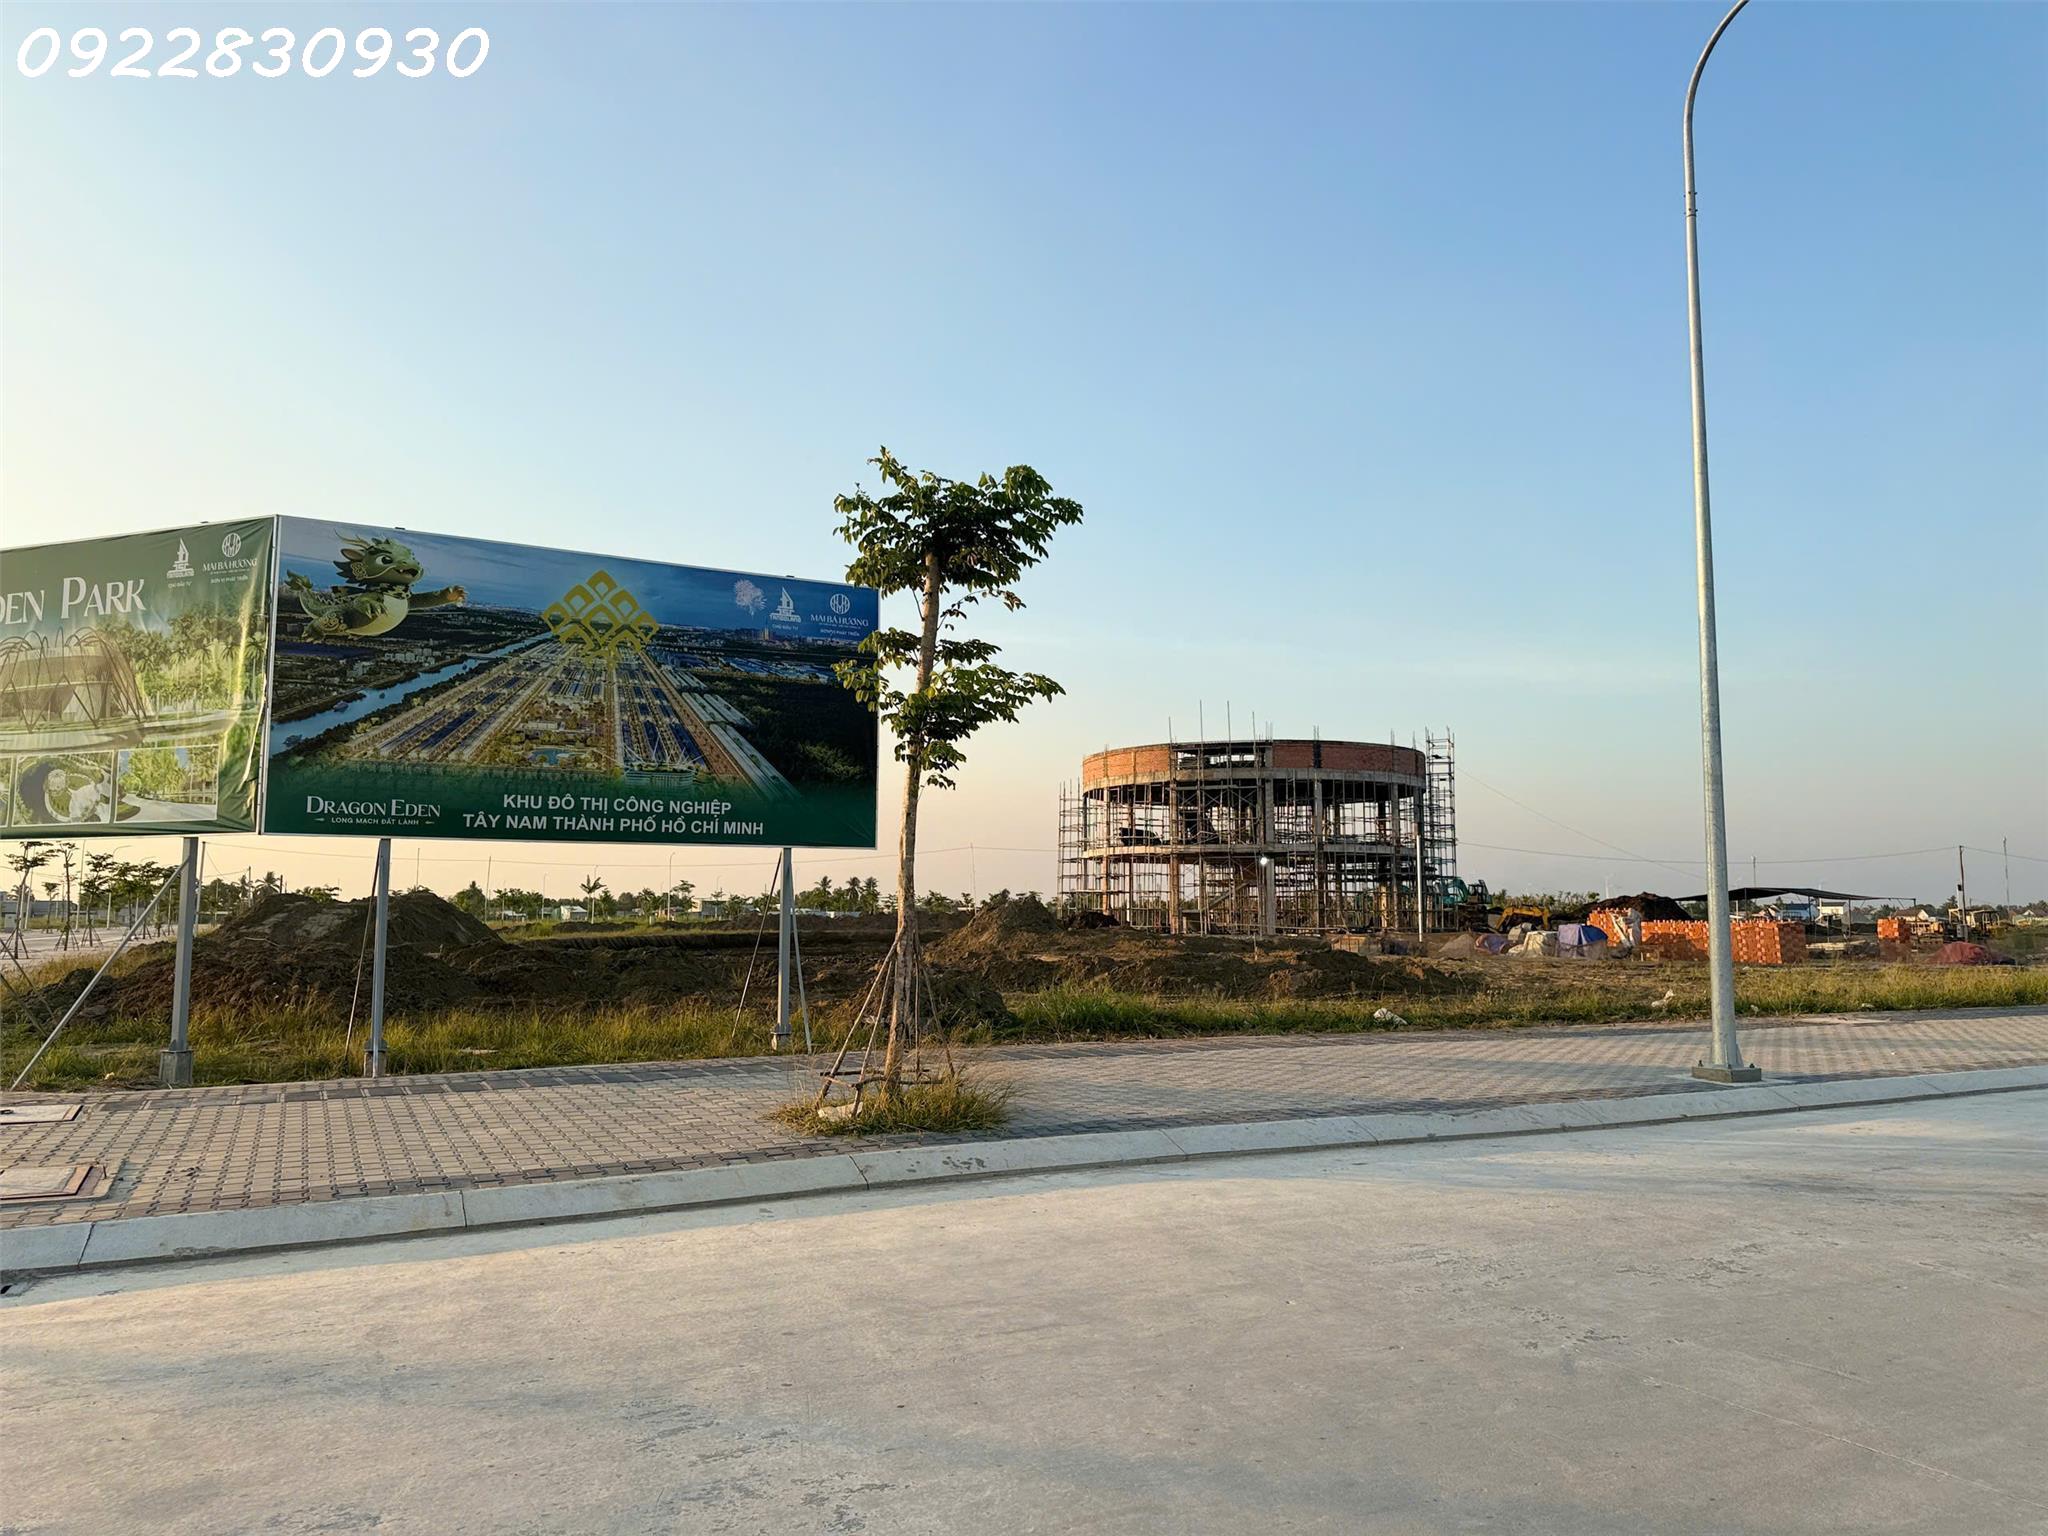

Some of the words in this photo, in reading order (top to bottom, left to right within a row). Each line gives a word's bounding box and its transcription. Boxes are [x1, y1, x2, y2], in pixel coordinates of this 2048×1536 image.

[0, 590, 45, 625] EN
[306, 795, 386, 816] DRAGON
[391, 799, 441, 817] EDEN
[503, 794, 542, 809] KHU
[548, 793, 575, 810] ĐÔ
[580, 797, 608, 814] THỊ
[613, 796, 664, 813] CÔNG
[669, 799, 732, 818] NGHIỆP
[462, 811, 501, 828] TÂY
[505, 815, 547, 830] NAM
[552, 814, 614, 831] THÀNH
[619, 814, 657, 832] PHỐ
[661, 815, 686, 833] HỒ
[690, 818, 719, 834] CHÍ
[723, 821, 764, 836] MINH
